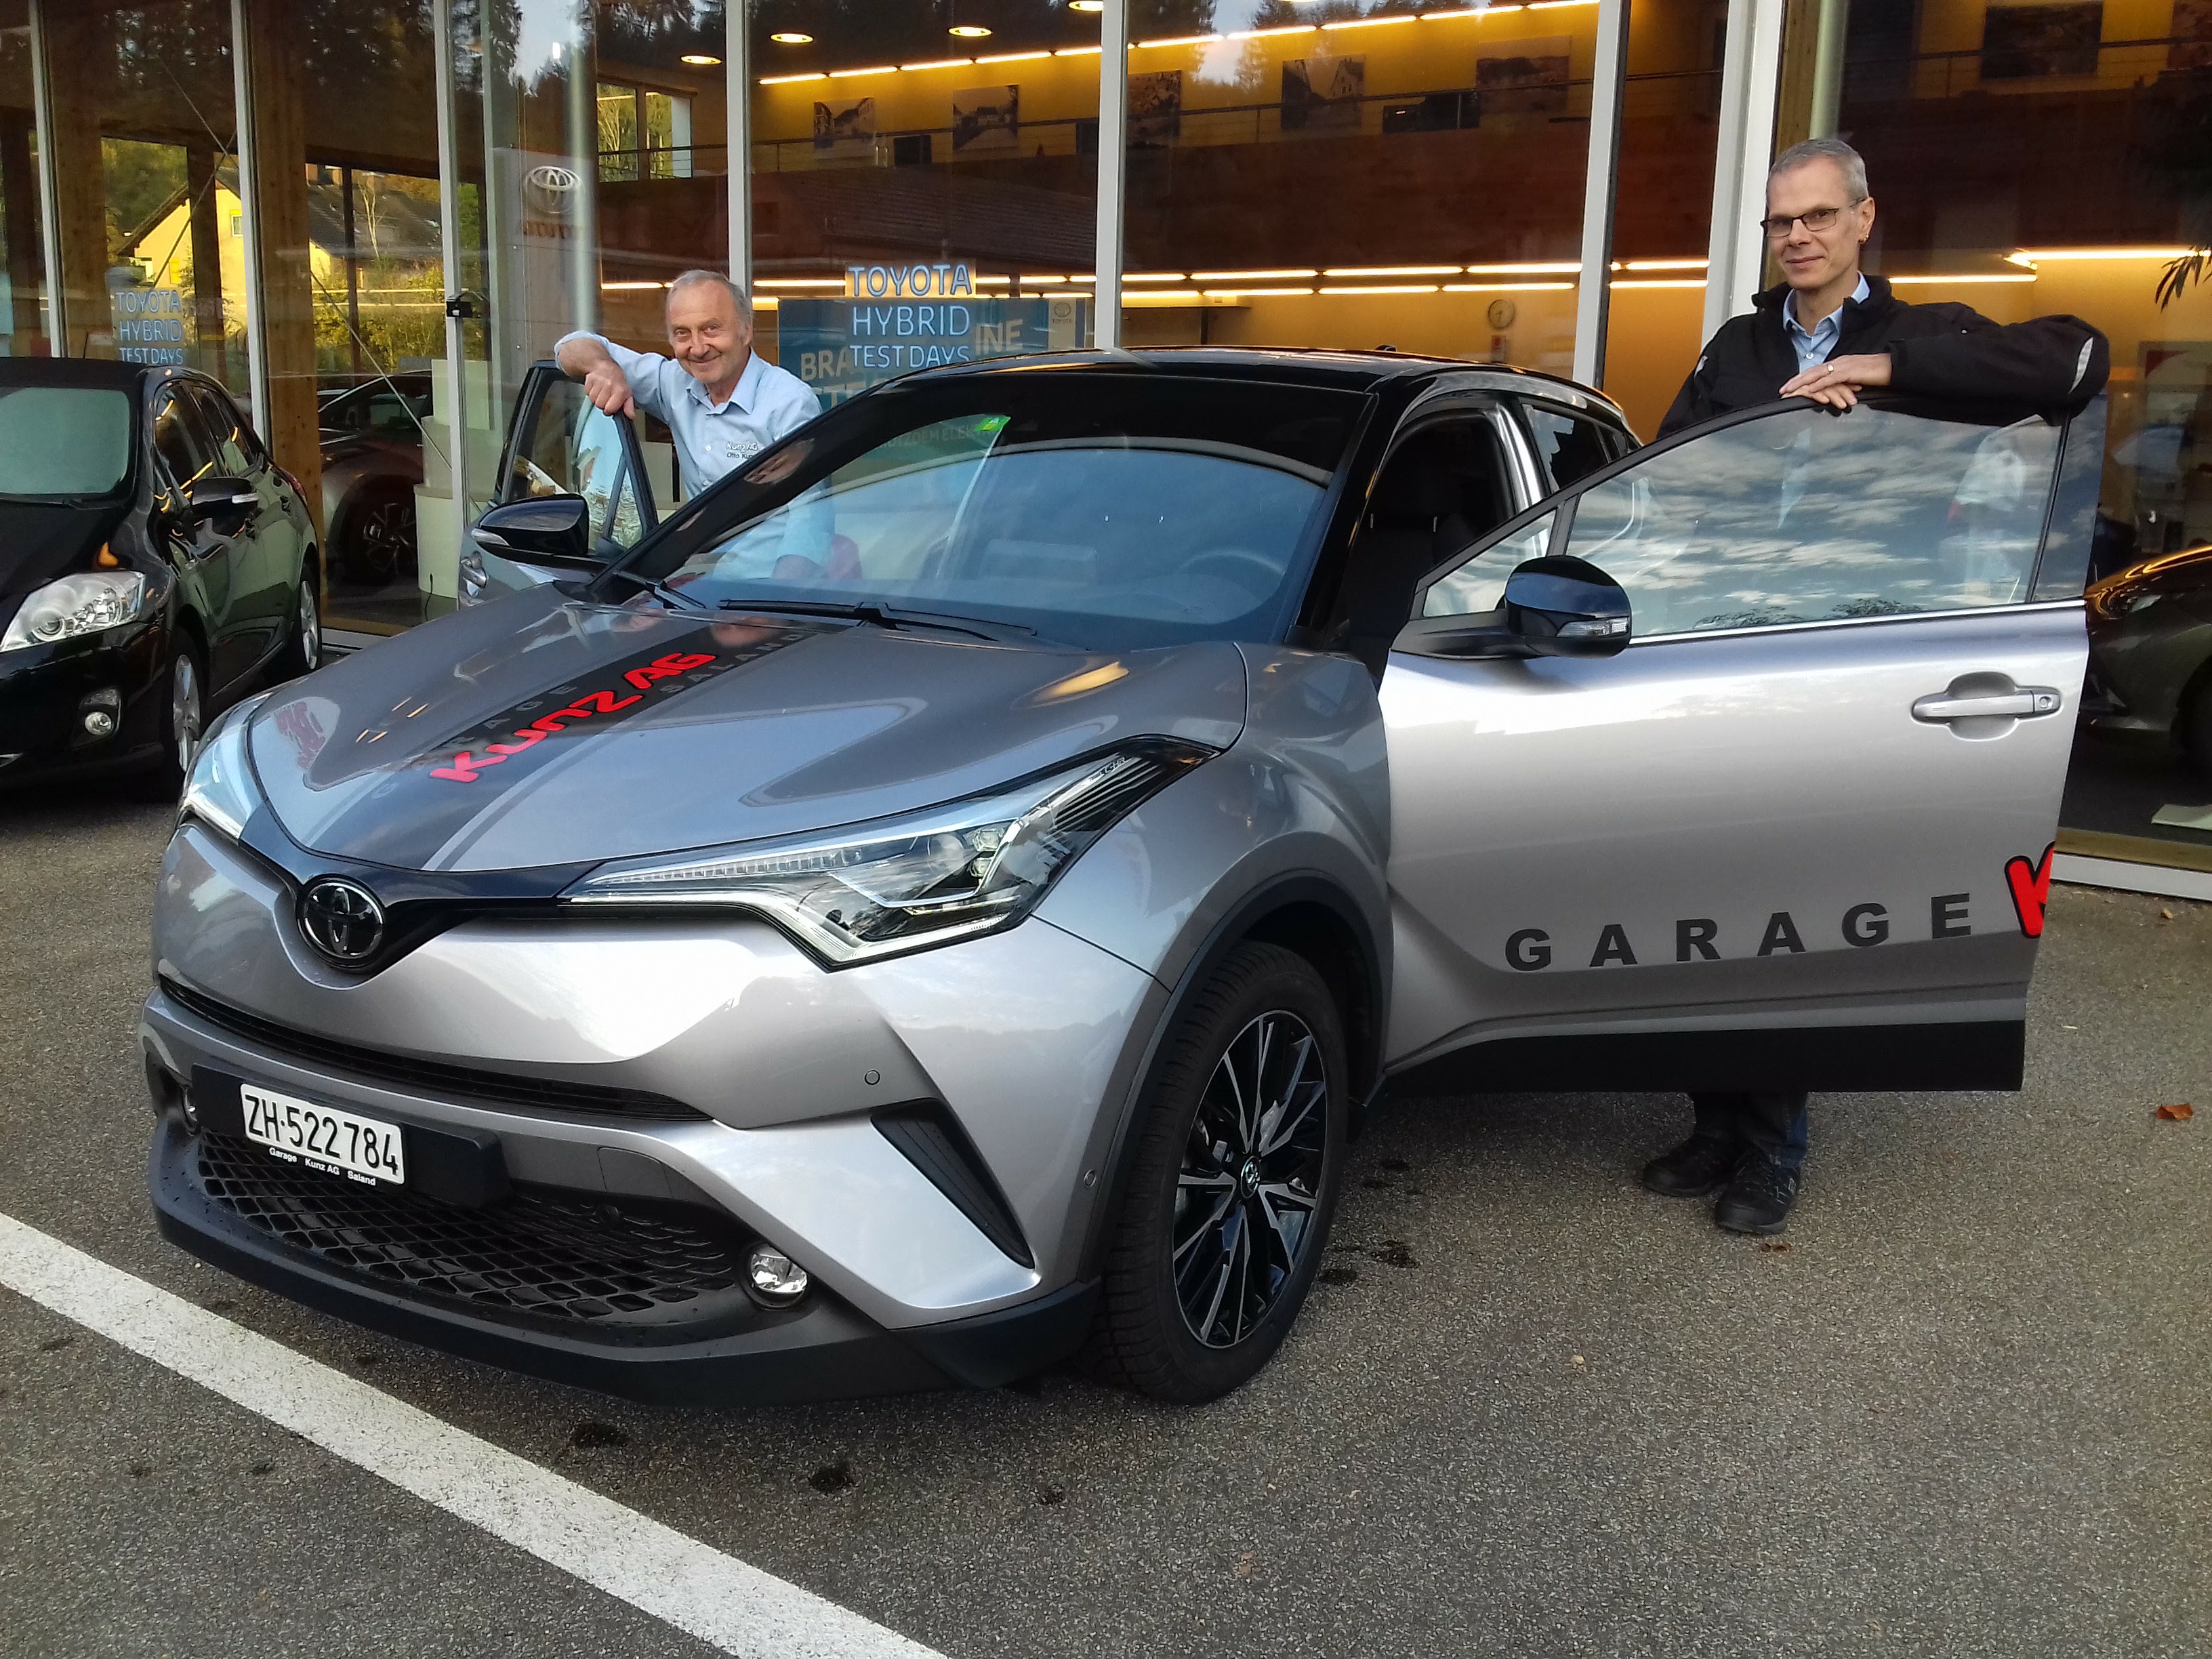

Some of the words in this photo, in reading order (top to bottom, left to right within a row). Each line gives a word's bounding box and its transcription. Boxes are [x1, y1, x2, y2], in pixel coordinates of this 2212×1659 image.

[848, 263, 972, 297] TOYOTA
[116, 290, 182, 313] TOYOTA
[120, 319, 184, 342] HYBRID
[853, 306, 970, 336] HYBRID
[975, 319, 1023, 356] INE
[119, 348, 148, 364] TEST
[150, 348, 184, 365] DAYS
[849, 345, 905, 368] TEST
[909, 345, 970, 368] DAYS
[726, 441, 746, 453] Kunz
[746, 441, 758, 451] AG
[623, 651, 718, 691] AG
[659, 634, 803, 693] SALAND
[1504, 892, 1972, 972] GARAGE
[269, 1147, 298, 1163] Garage
[305, 1158, 326, 1171] Kunz
[327, 1164, 340, 1176] AG
[347, 1170, 376, 1186] Saland
